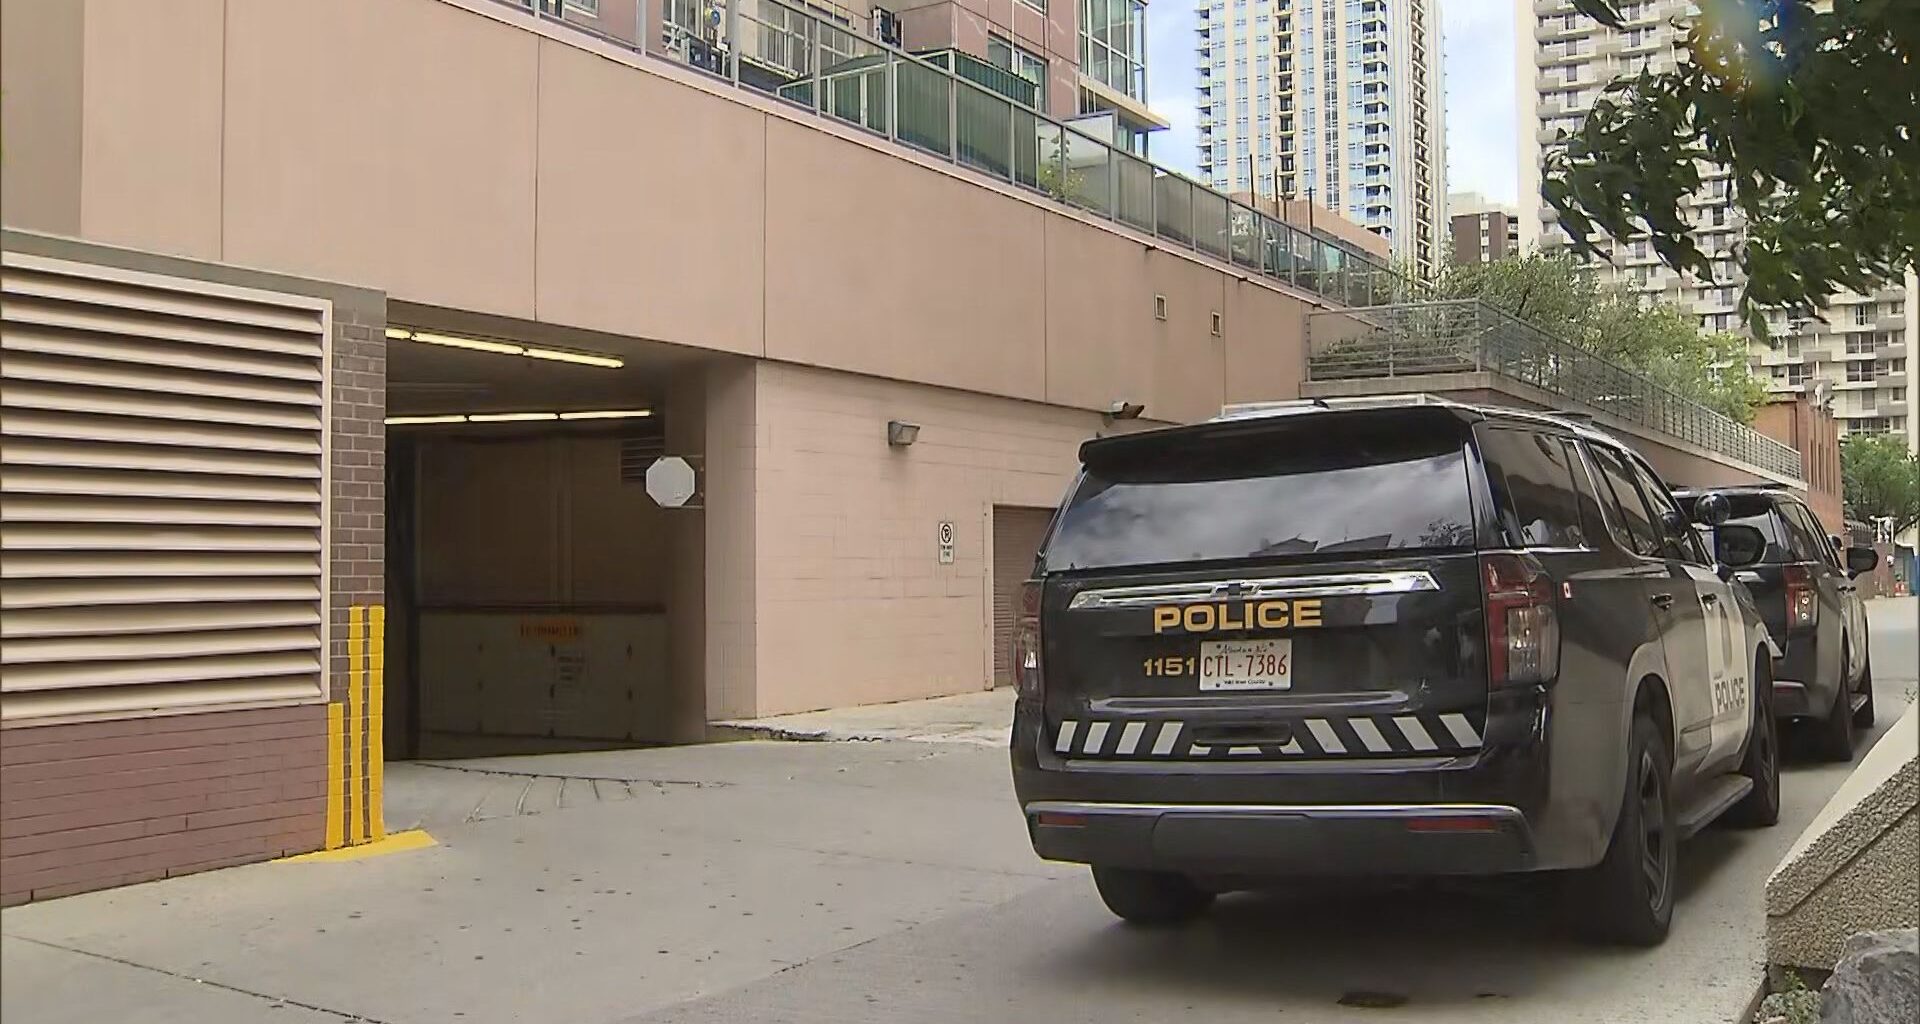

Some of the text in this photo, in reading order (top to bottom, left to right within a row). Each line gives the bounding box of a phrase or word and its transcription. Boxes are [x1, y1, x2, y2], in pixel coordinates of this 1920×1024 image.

[1154, 600, 1322, 633] POLICE
[1143, 657, 1196, 677] 1151
[1203, 654, 1287, 678] CTL-7386
[1715, 677, 1744, 713] POLICE
